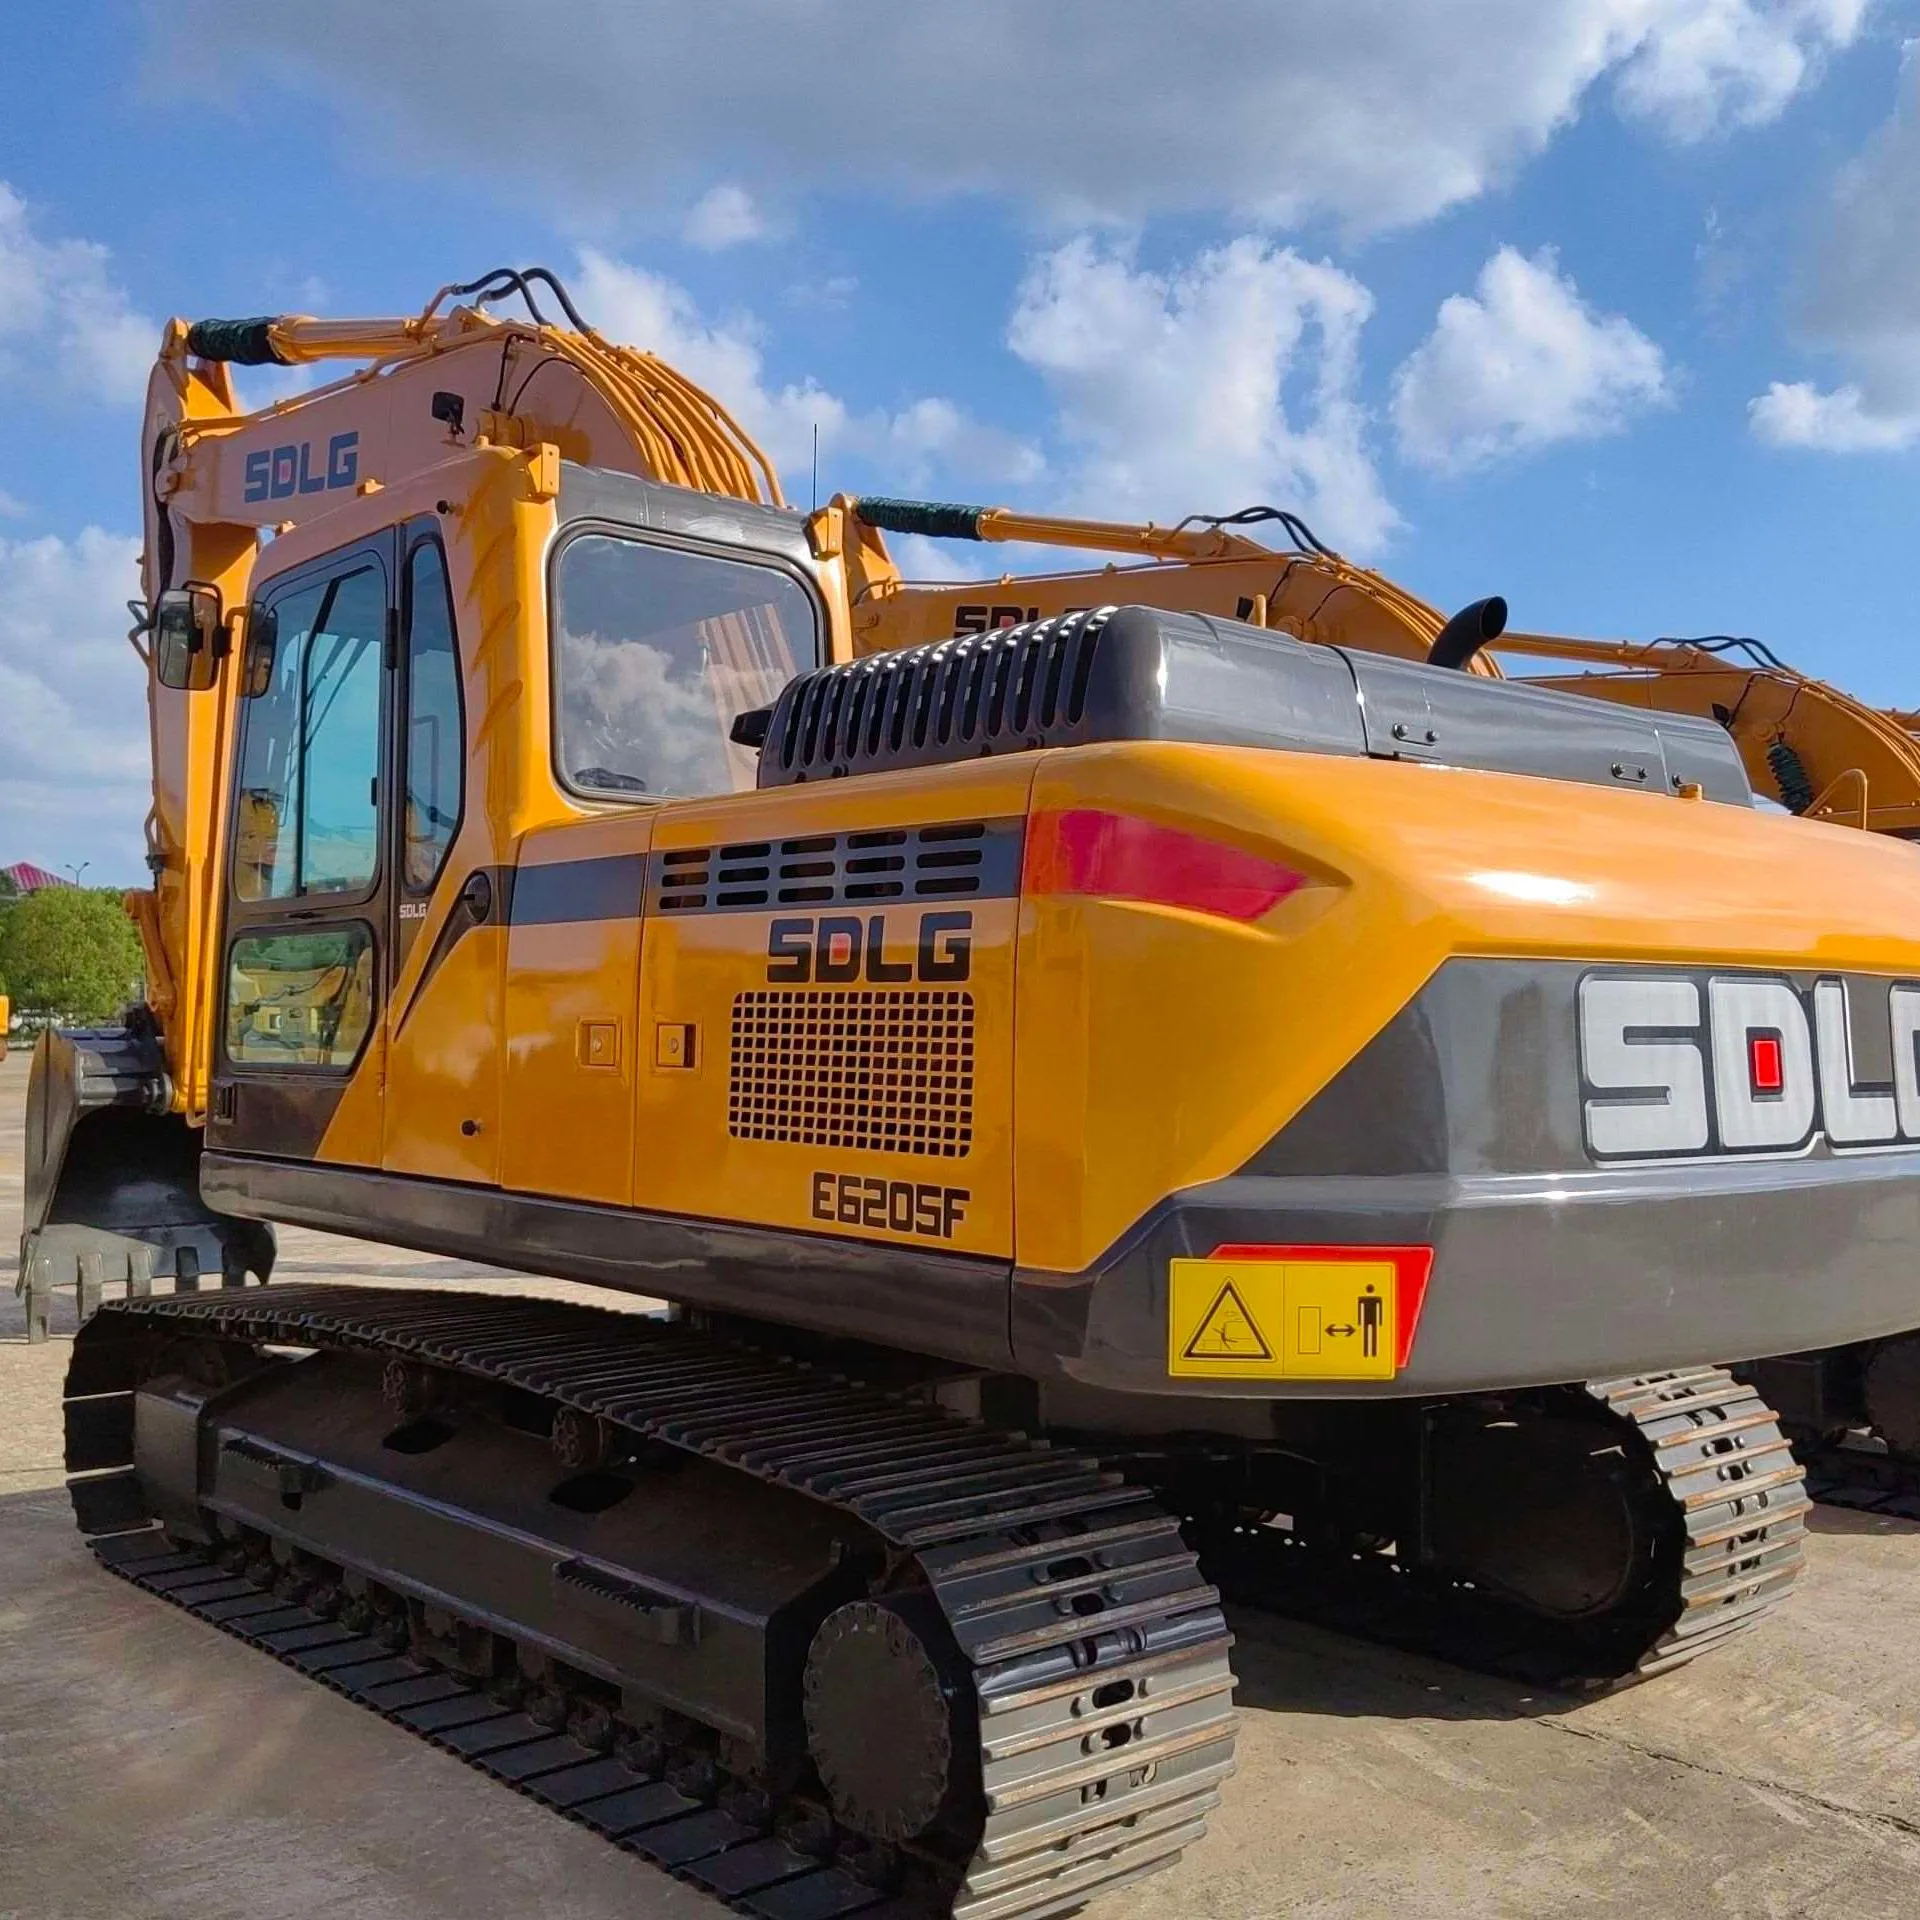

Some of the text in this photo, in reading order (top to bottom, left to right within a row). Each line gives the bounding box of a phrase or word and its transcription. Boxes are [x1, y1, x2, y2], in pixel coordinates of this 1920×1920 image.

[244, 431, 359, 503] SDLG
[954, 606, 1093, 638] SD
[399, 903, 427, 919] SDLG
[766, 911, 973, 983] SDLG
[1576, 972, 1920, 1156] SDL
[812, 1171, 971, 1238] E620SF
